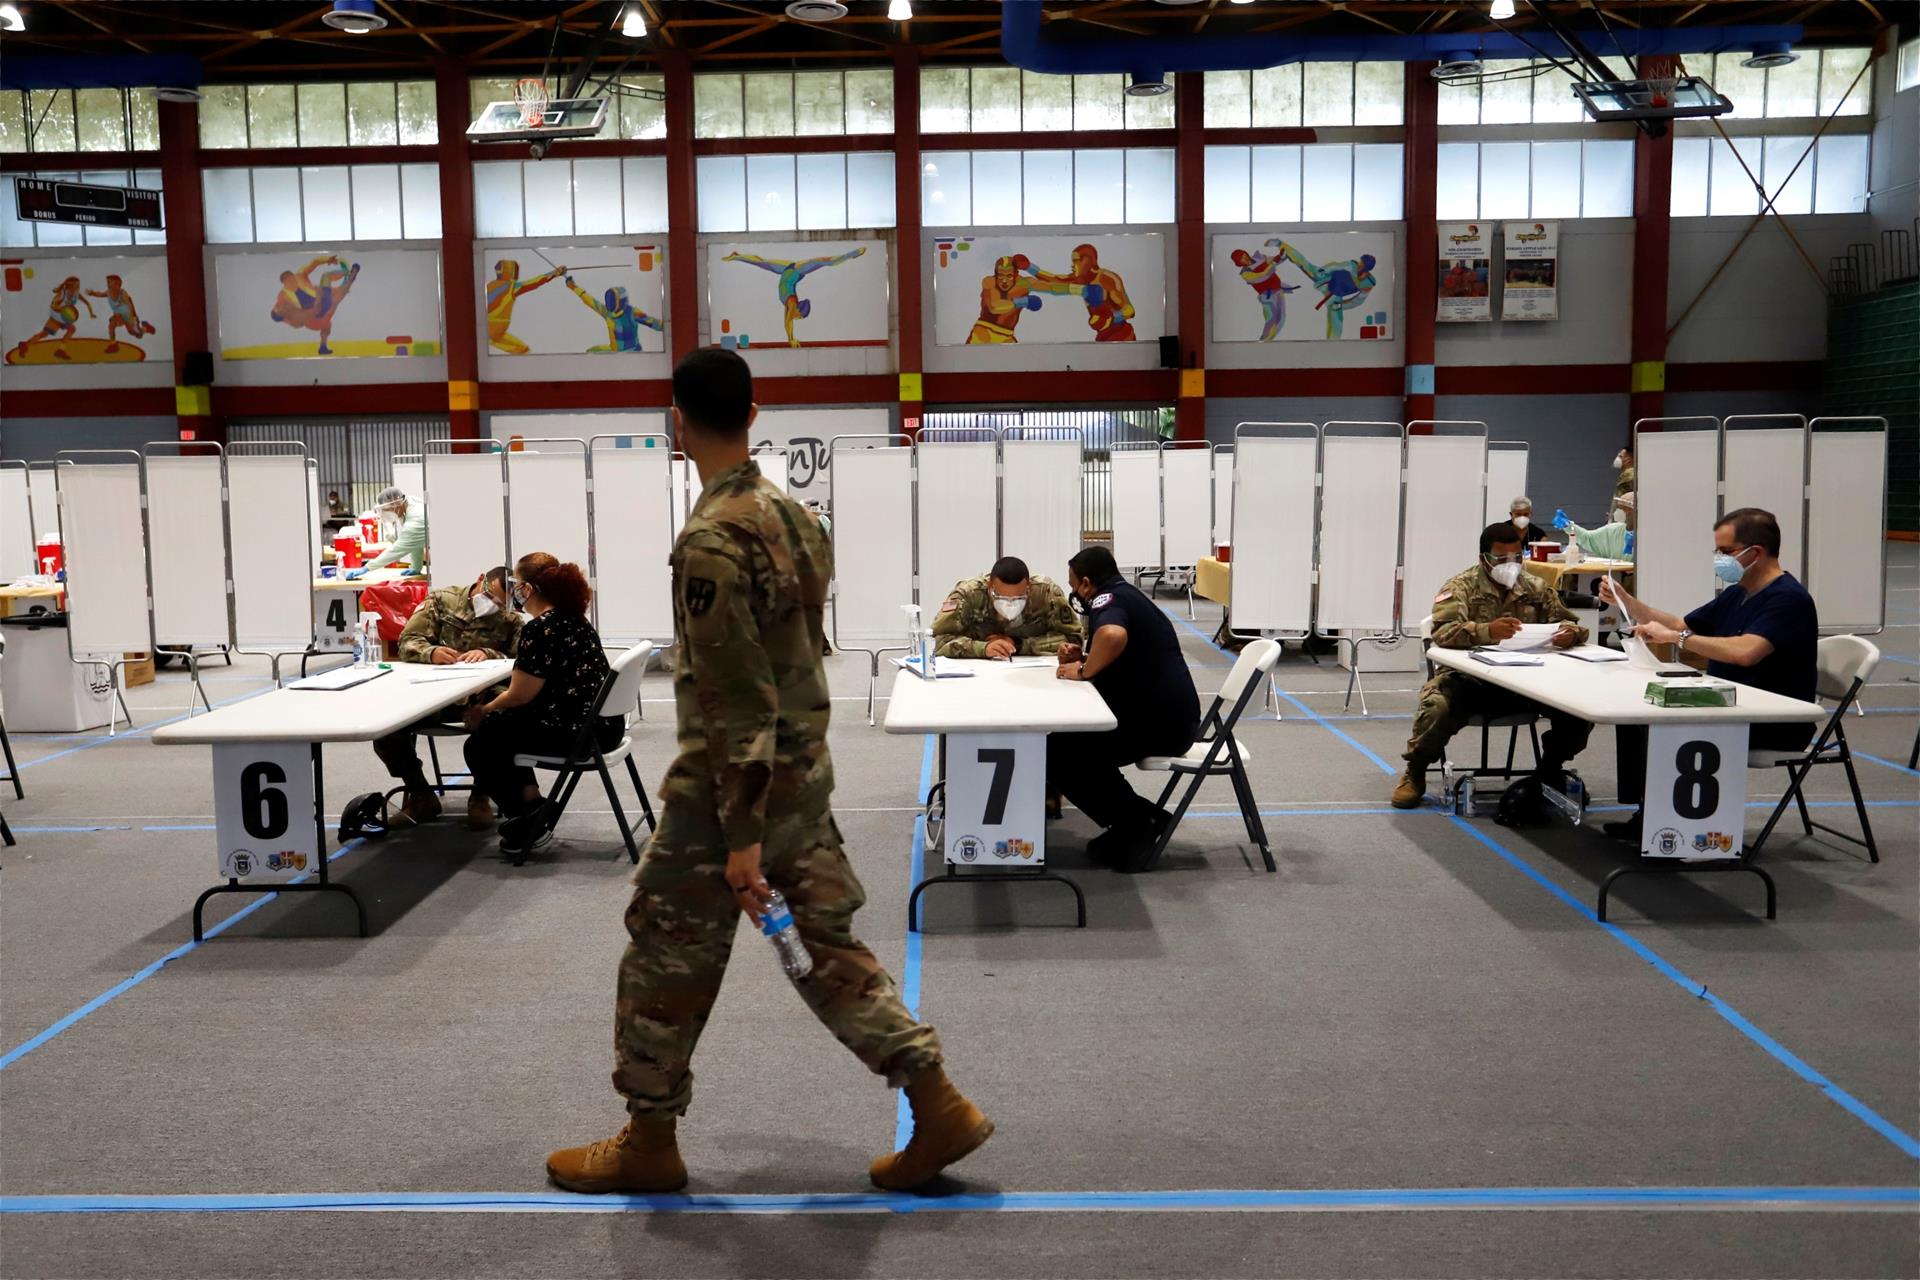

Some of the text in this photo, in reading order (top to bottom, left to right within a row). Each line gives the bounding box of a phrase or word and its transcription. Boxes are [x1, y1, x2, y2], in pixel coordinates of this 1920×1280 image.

[20, 180, 52, 191] HOME
[126, 190, 157, 201] VISITOR
[33, 210, 57, 219] BONUS
[326, 599, 347, 632] 4
[977, 748, 1016, 825] 7
[1672, 739, 1721, 820] 8
[240, 761, 289, 840] 6
